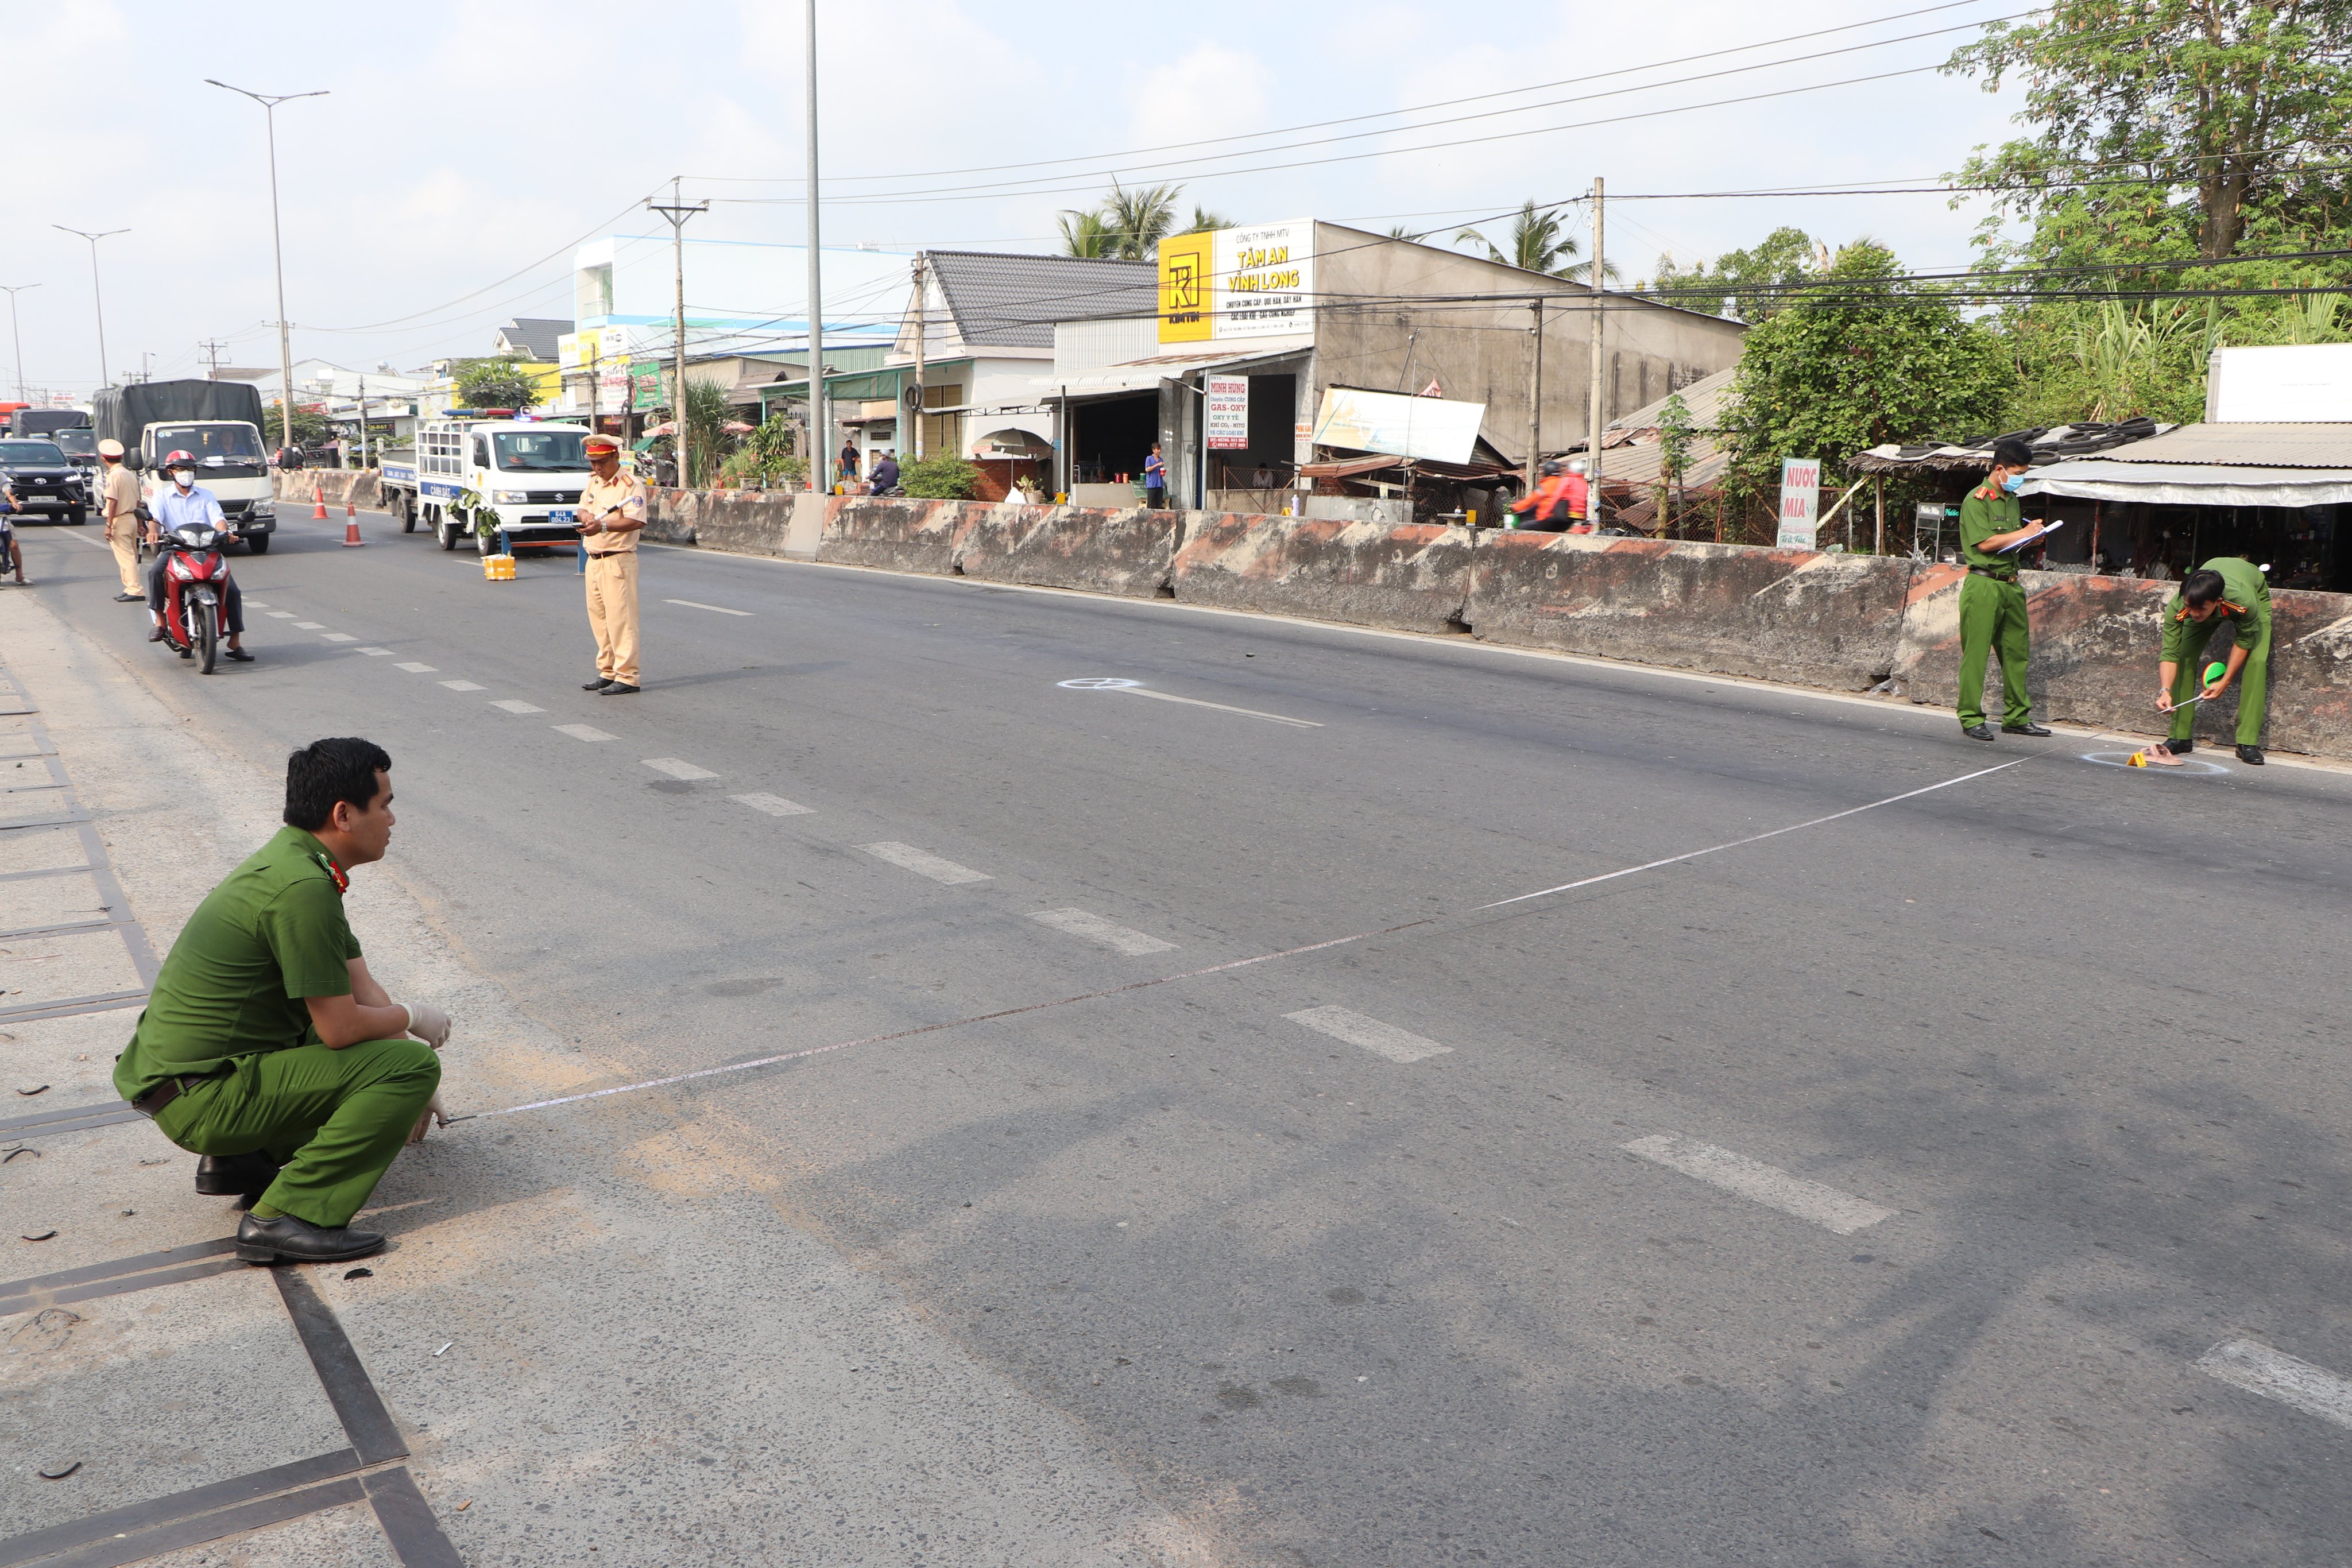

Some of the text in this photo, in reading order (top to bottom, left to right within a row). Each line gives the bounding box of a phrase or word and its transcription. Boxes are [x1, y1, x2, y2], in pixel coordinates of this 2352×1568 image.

[1236, 229, 1289, 243] CÔNG TY TNHH MTV
[1237, 246, 1288, 268] TÂM AN
[1228, 269, 1299, 293] VĨNH LONG
[1211, 380, 1245, 393] MINH HÙNG
[1786, 463, 1817, 488] NƯỚC
[431, 483, 450, 497] CẢNH SÁT
[1782, 493, 1806, 518] MÍA
[2138, 753, 2142, 764] 1
